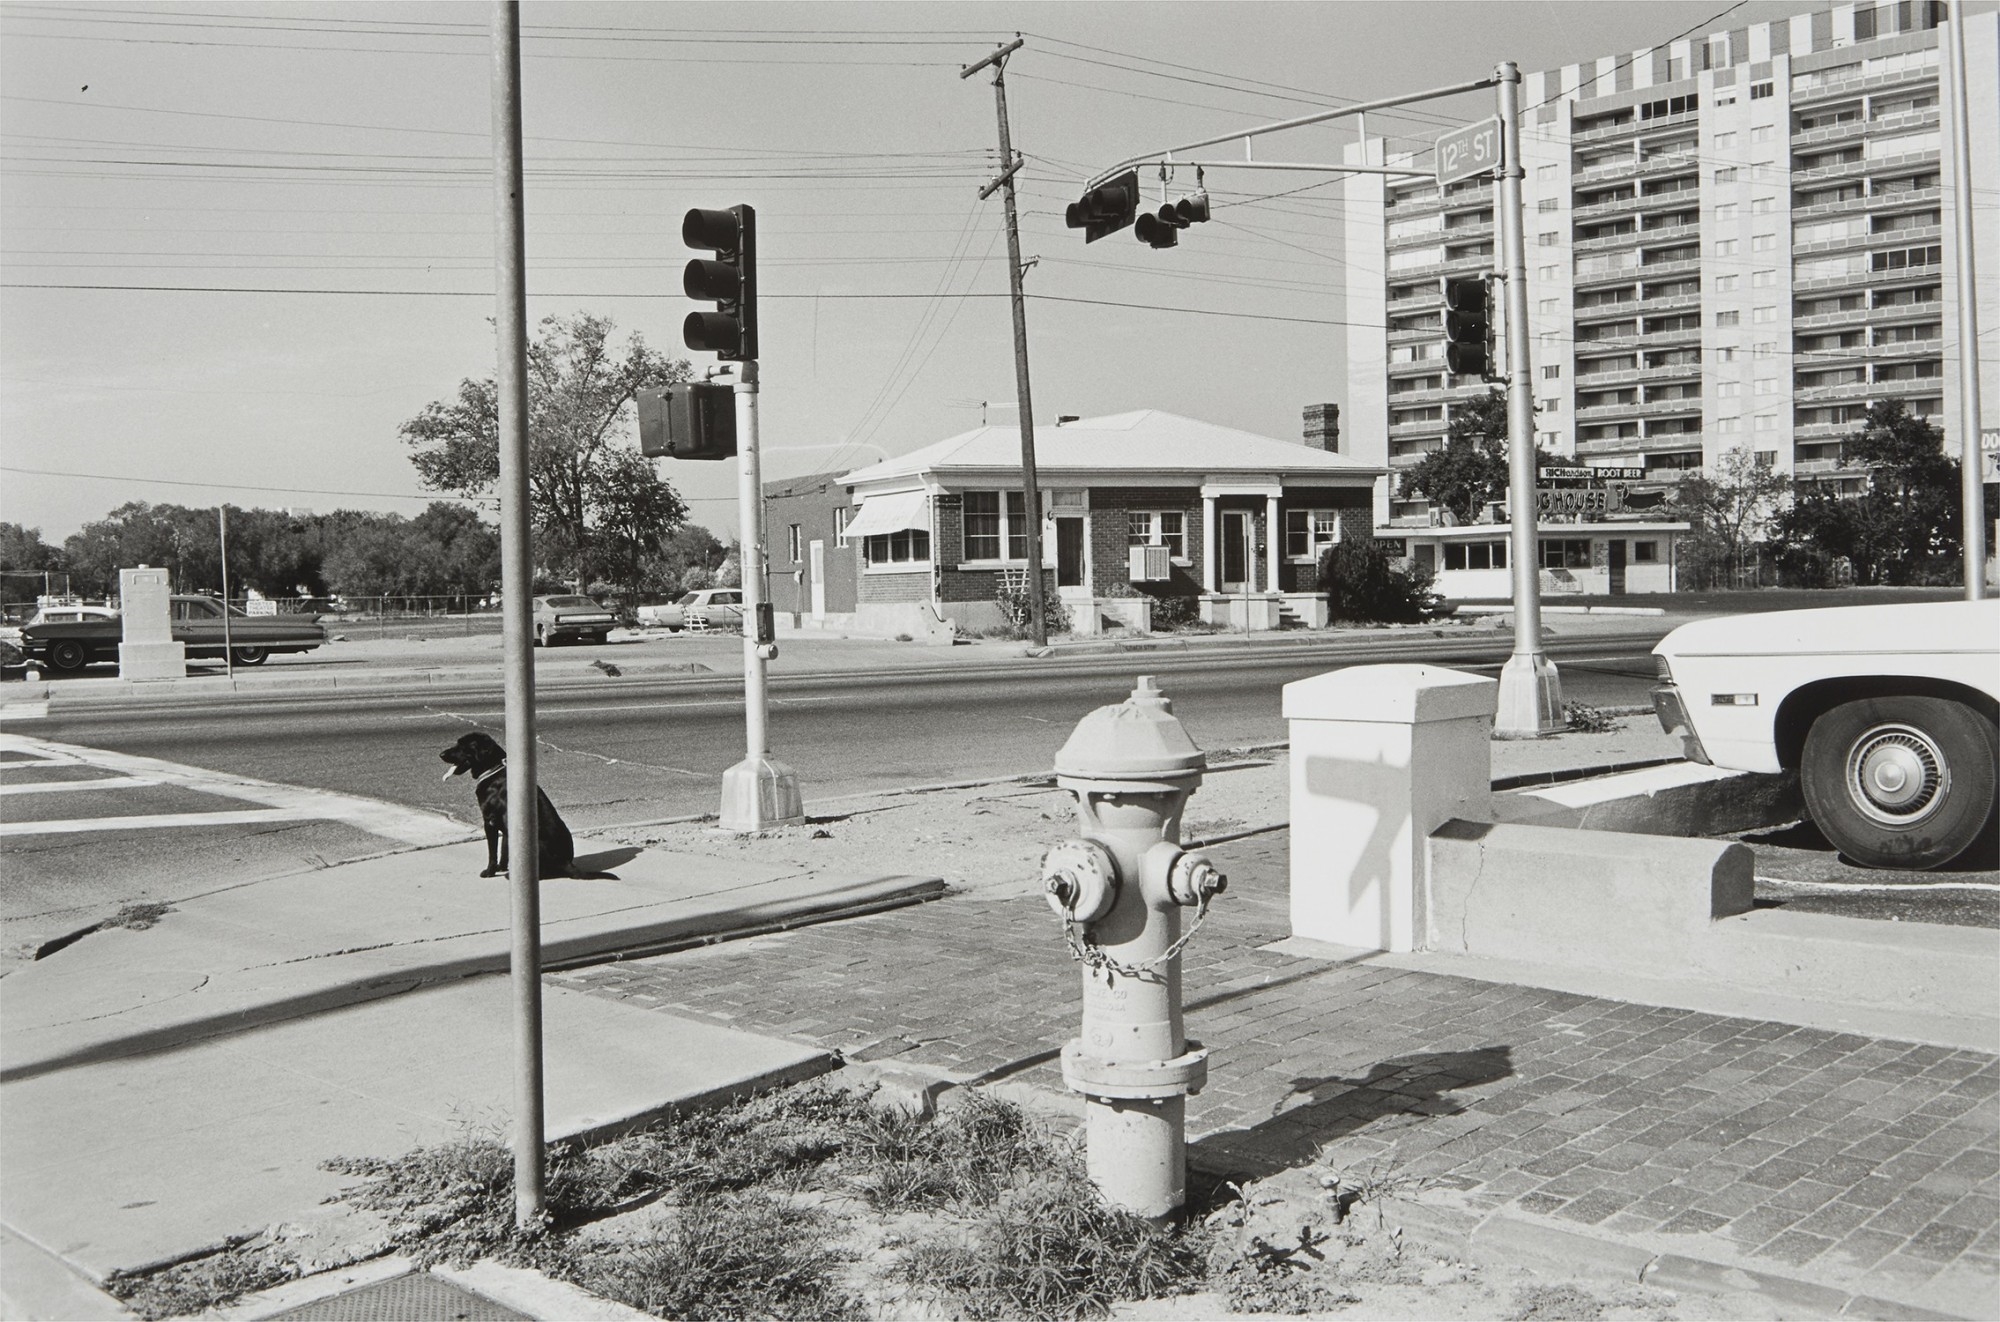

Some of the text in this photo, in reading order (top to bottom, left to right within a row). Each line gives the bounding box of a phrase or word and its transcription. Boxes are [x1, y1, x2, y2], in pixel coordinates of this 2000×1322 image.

[1441, 129, 1493, 173] 12TH ST
[1597, 468, 1641, 478] ROOT BEER
[1553, 491, 1607, 510] HOUSE
[1372, 540, 1401, 549] OPEN
